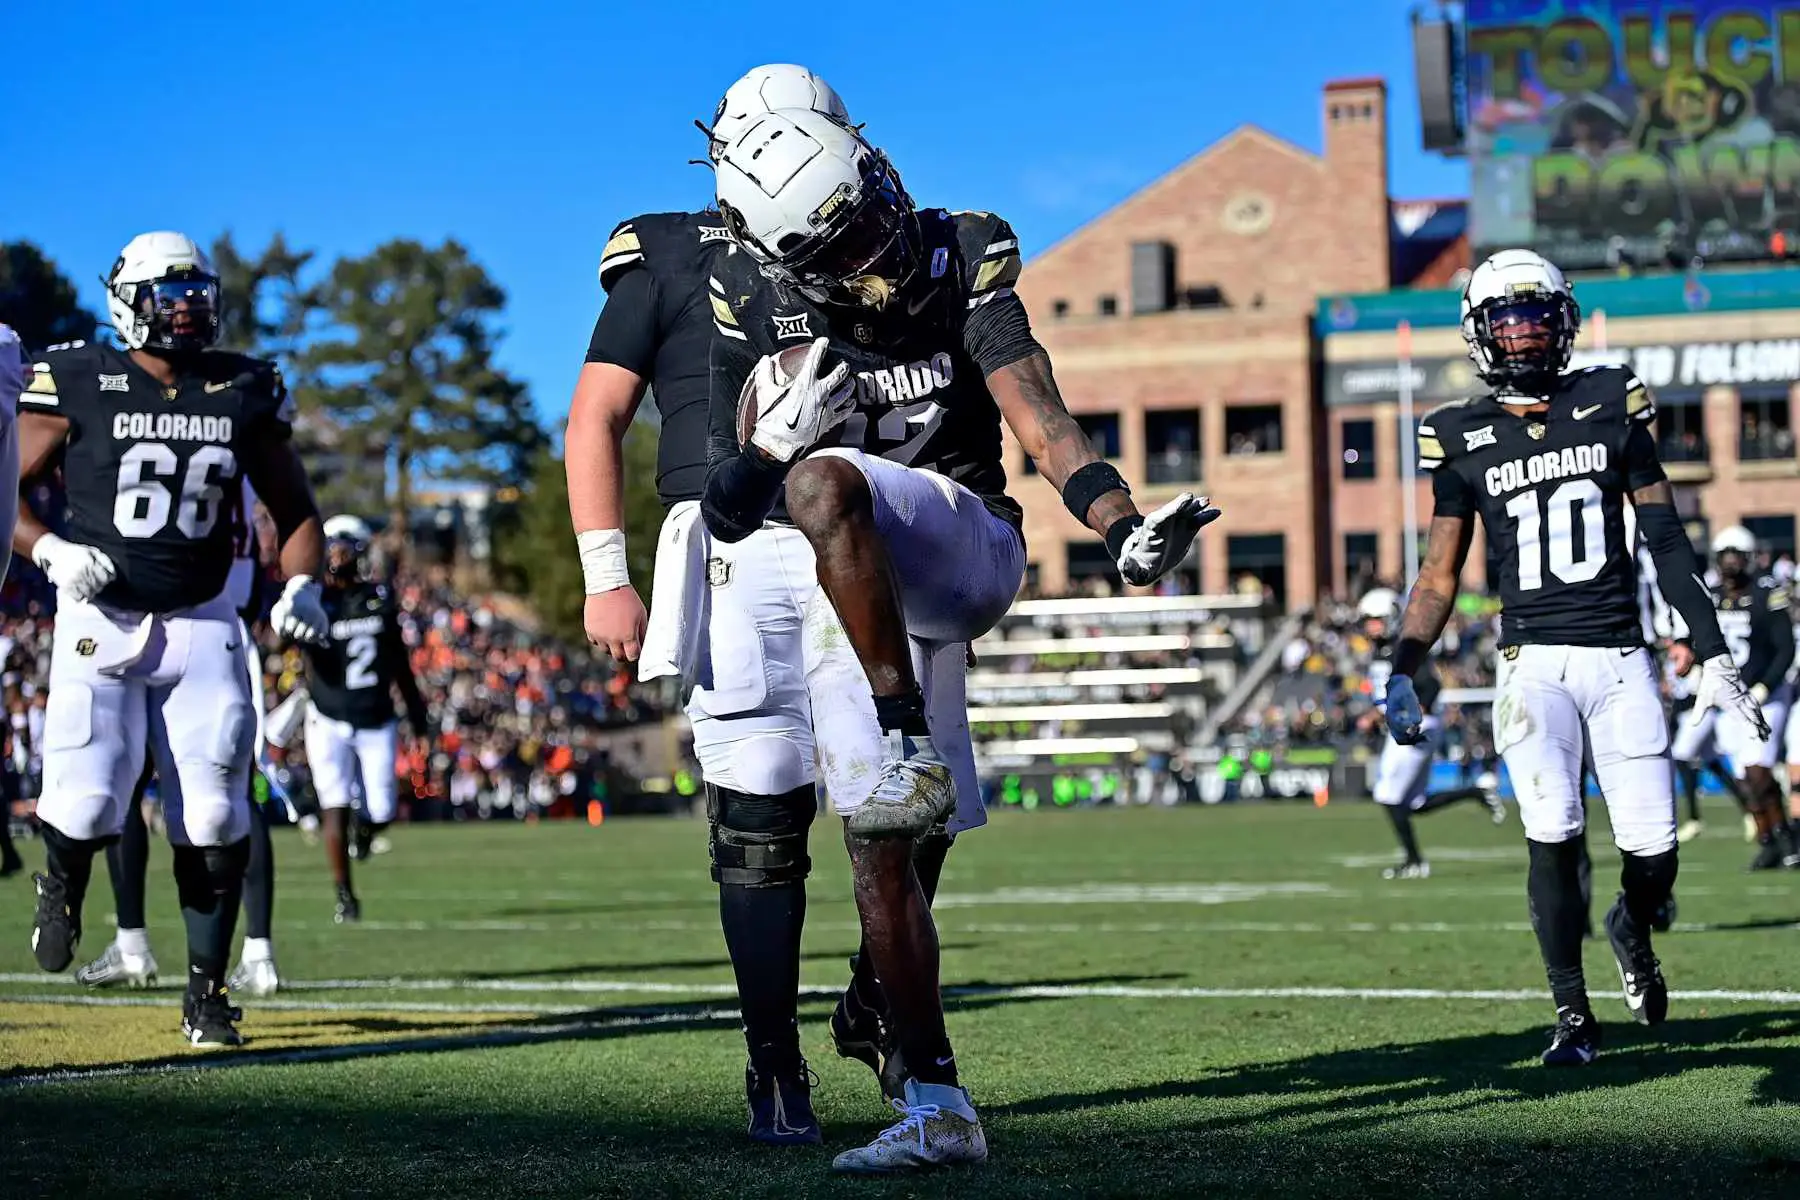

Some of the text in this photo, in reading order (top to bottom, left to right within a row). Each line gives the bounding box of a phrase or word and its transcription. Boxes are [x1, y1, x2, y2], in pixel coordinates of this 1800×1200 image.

[818, 191, 844, 218] BUFFS
[856, 351, 953, 405] ORADO
[1634, 346, 1675, 387] TO
[113, 412, 232, 443] COLORADO
[113, 442, 237, 540] 66
[1484, 443, 1608, 497] COLORADO
[1505, 478, 1607, 591] 10
[345, 635, 379, 690] 2
